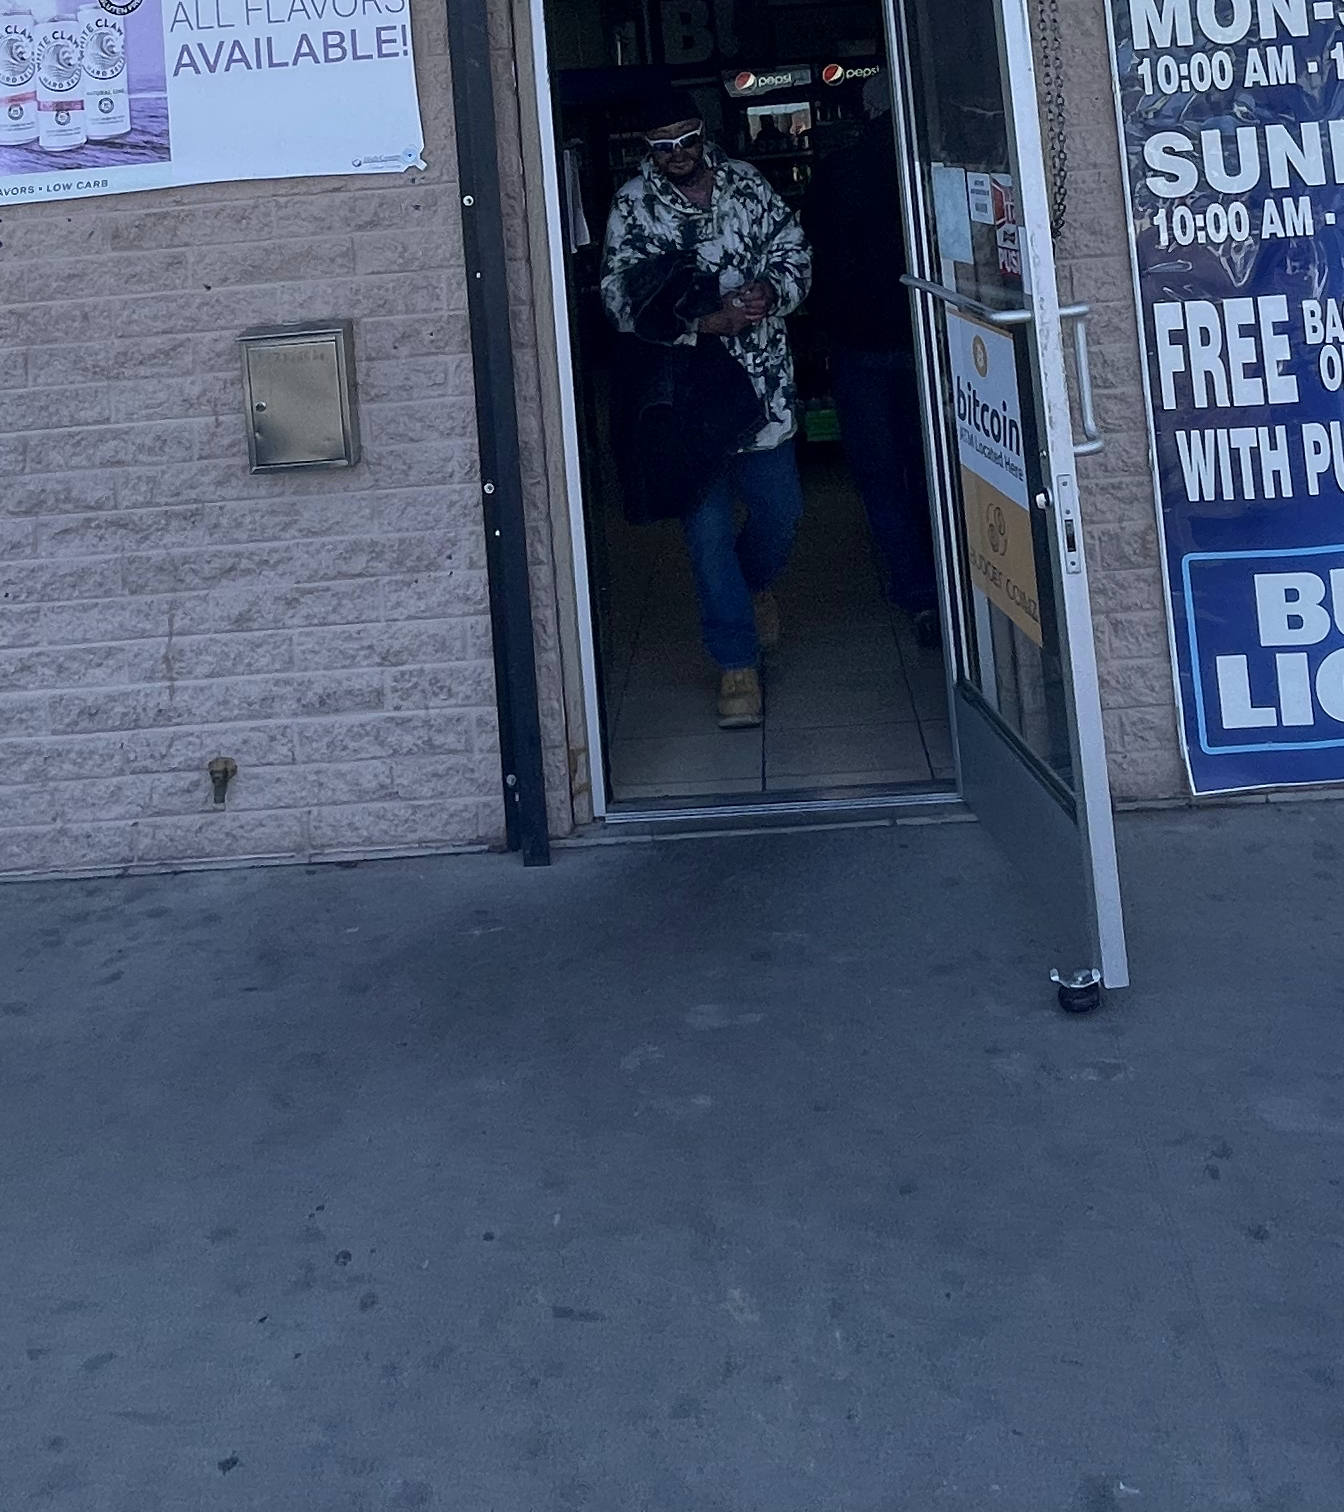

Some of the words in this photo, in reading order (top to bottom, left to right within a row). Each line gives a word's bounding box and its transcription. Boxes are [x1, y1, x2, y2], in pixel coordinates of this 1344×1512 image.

[173, 24, 409, 77] AVAILABLE!
[846, 65, 880, 80] pepsi
[1137, 50, 1234, 95] 10:00
[1244, 46, 1297, 88] AM
[758, 72, 792, 88] pepsi
[46, 181, 72, 193] LOW
[76, 179, 109, 190] CARB
[1153, 203, 1250, 247] 10:00
[1260, 196, 1315, 240] AM
[1153, 294, 1300, 410] FREE
[956, 375, 1021, 457] bitcoin
[1175, 423, 1295, 503] WITH
